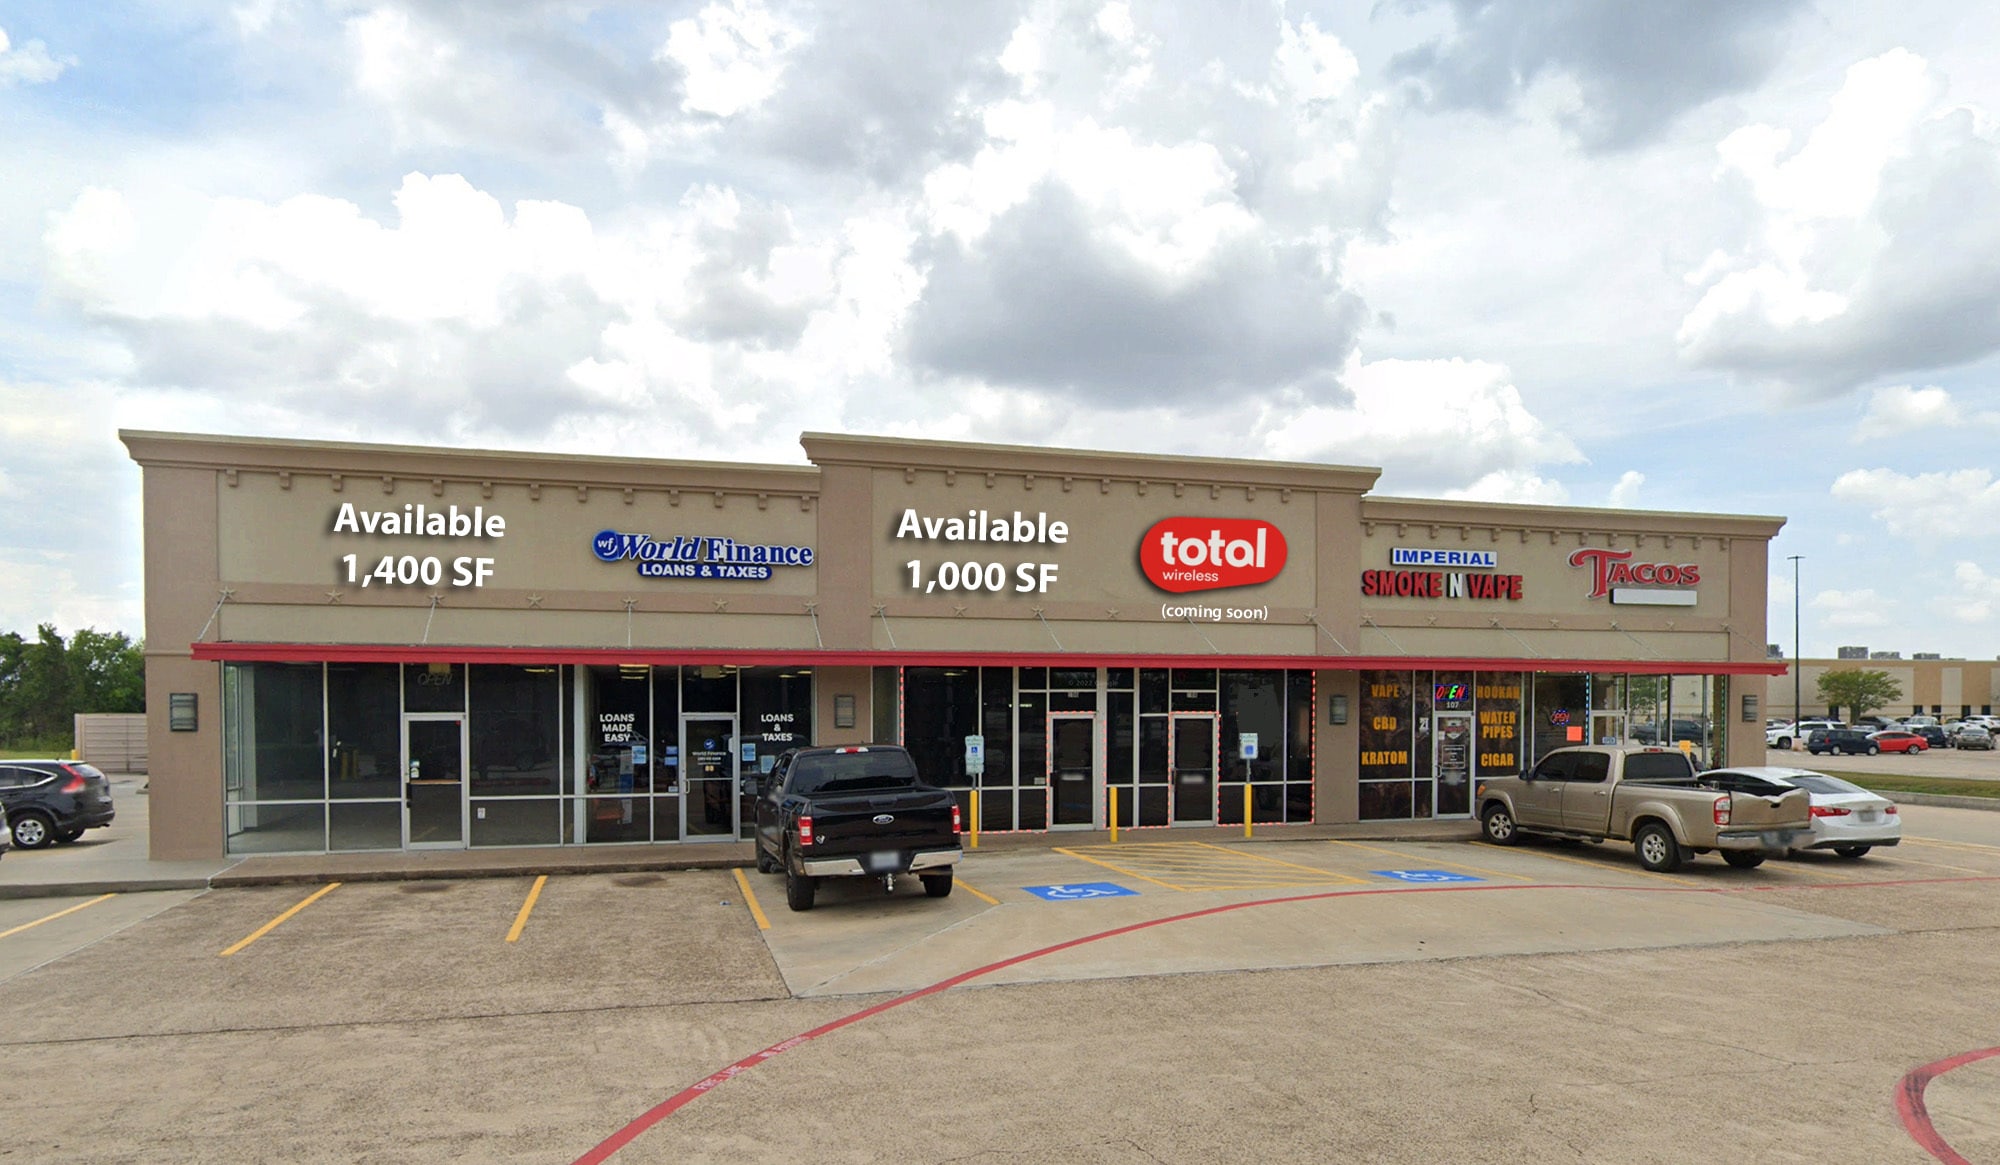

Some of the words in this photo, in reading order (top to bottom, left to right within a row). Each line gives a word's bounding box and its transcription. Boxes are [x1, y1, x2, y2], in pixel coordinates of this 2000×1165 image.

[616, 534, 701, 561] World
[704, 537, 813, 565] Finance
[1161, 528, 1266, 568] total
[1395, 550, 1494, 565] IMPERIAL
[642, 564, 695, 576] LOANS
[701, 566, 712, 577] &
[717, 566, 768, 578] TAXES
[1163, 569, 1219, 582] wireless
[1363, 570, 1443, 598] SMOKE
[1449, 573, 1462, 597] N
[1468, 574, 1523, 599] VAPE
[1371, 684, 1400, 698] VAPE
[1436, 685, 1466, 699] OPEN
[1477, 686, 1520, 699] HOOKAH
[1446, 701, 1459, 709] 107
[600, 713, 635, 722] LOANS
[761, 713, 794, 722] LOANS
[1373, 717, 1397, 730] CBD
[1480, 711, 1516, 724] WATER
[602, 724, 632, 732] MADE
[774, 723, 781, 731] &
[1482, 726, 1513, 739] PIPES
[605, 733, 630, 742] EASY
[762, 733, 793, 741] TAXES
[1361, 751, 1408, 765] KRATOM
[1481, 753, 1514, 767] CIGAR
